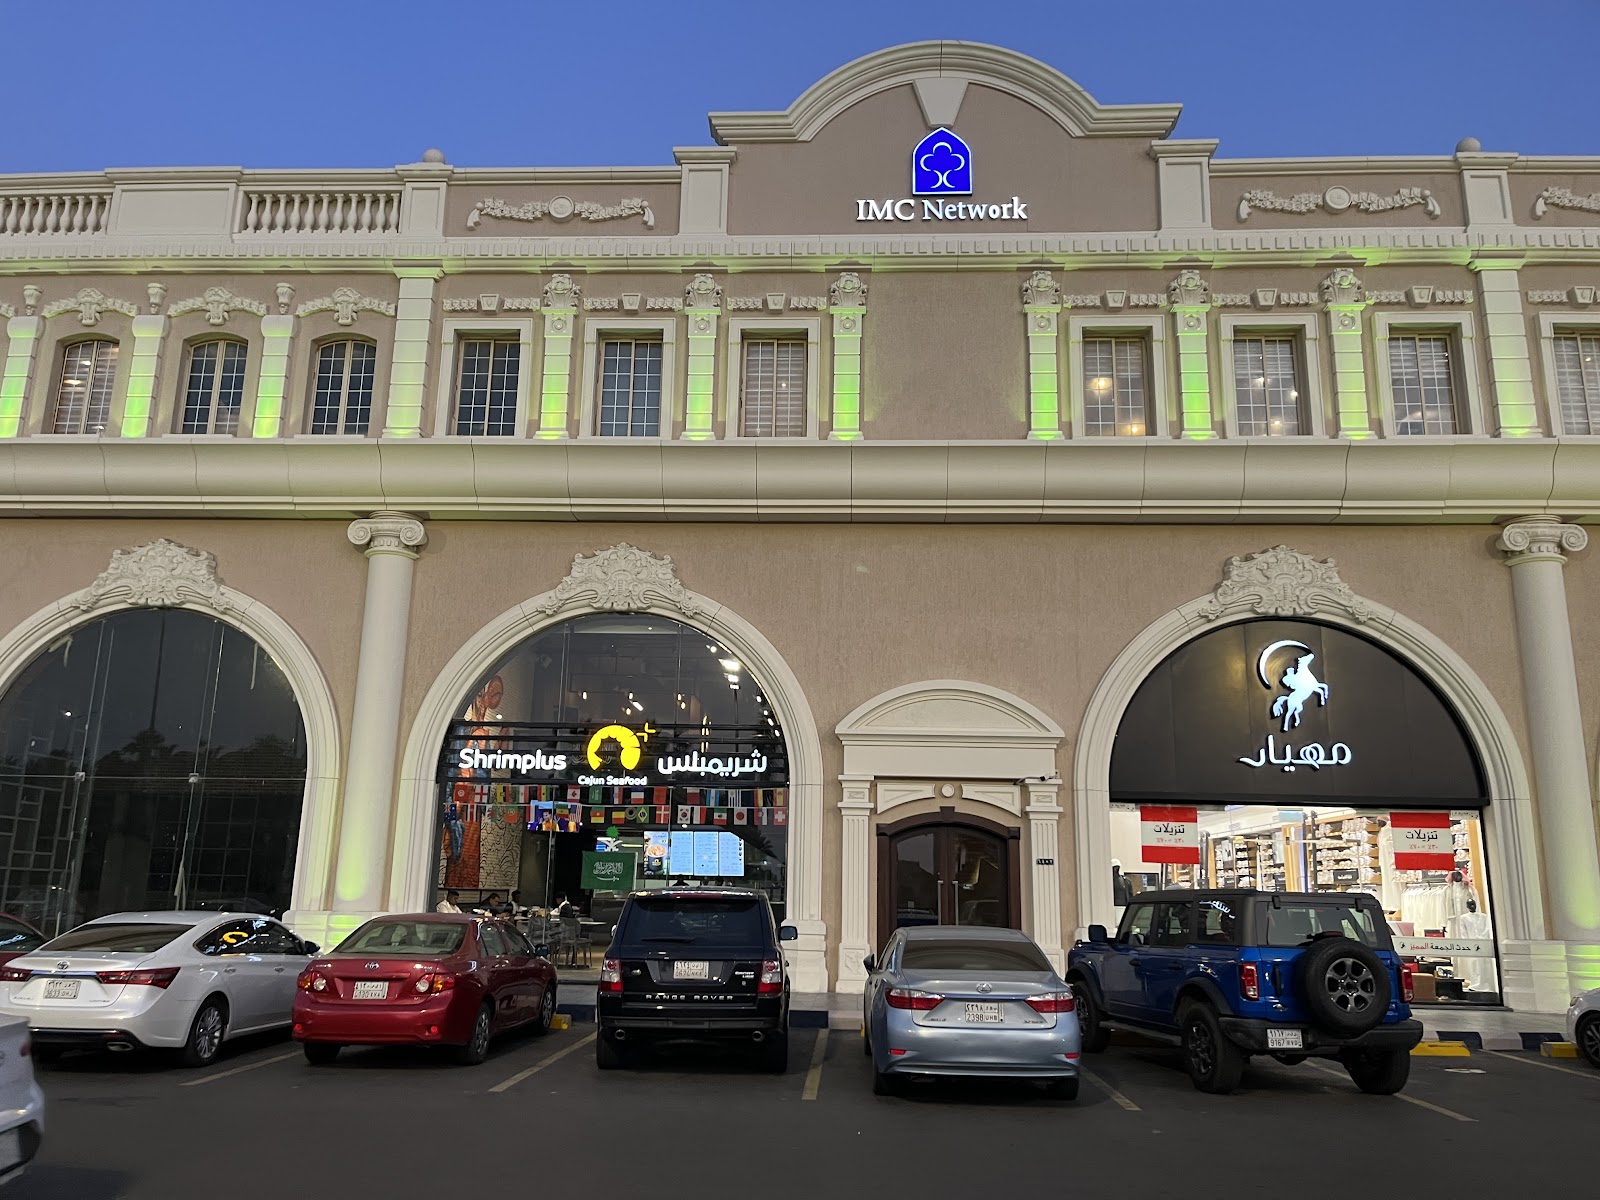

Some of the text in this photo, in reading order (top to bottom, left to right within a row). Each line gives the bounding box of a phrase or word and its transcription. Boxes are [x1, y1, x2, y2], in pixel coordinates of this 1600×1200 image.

[856, 196, 1028, 221] IMC Network
[1239, 735, 1352, 772] مهيار
[458, 748, 567, 774] Shrimplus
[657, 748, 768, 777] شريمبلس
[577, 774, 648, 786] Cajun Seafood
[1153, 822, 1185, 836] تنزيلات
[1405, 829, 1438, 842] تنزيلات
[1429, 942, 1455, 951] الجمعة
[1455, 943, 1471, 951] حدث
[966, 1013, 984, 1022] 2398
[1270, 1038, 1285, 1047] 9167
